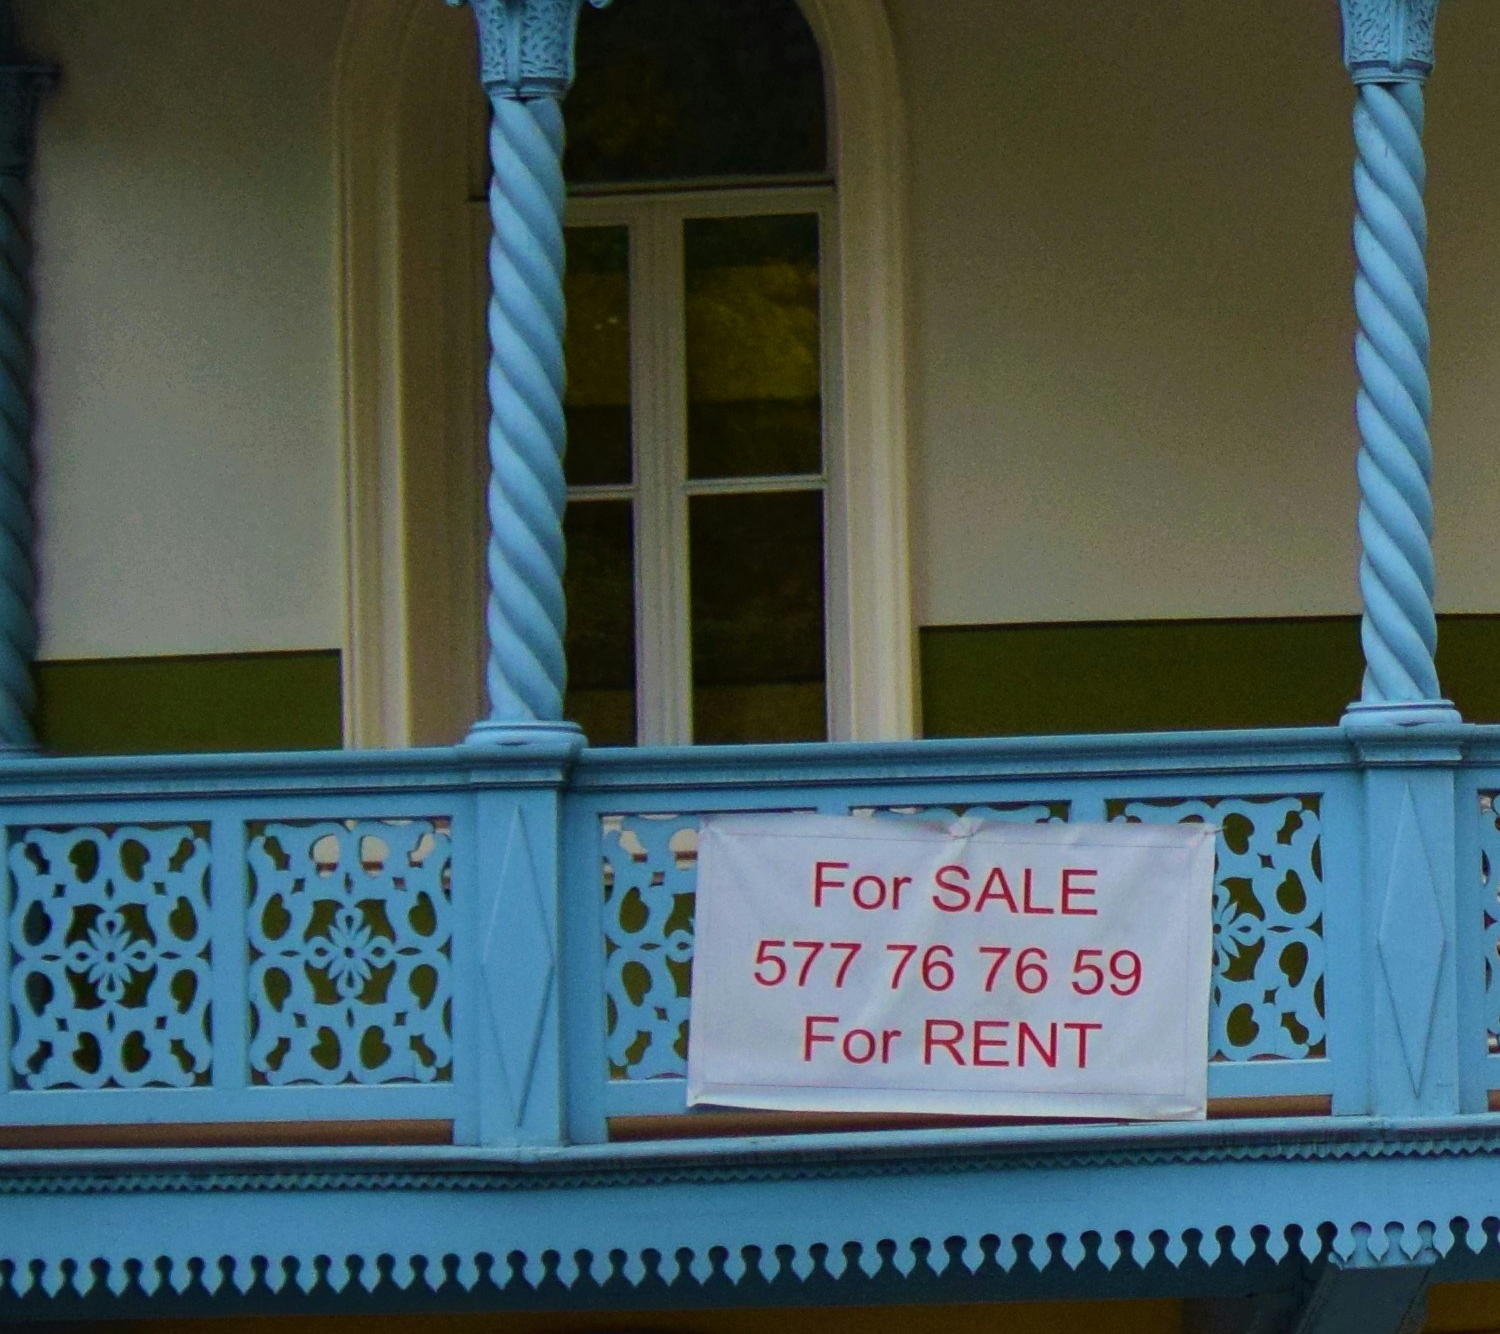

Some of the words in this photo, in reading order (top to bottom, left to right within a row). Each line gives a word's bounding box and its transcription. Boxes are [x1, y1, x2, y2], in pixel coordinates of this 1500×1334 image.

[813, 861, 912, 910] For
[932, 865, 1099, 916] SALE
[754, 939, 862, 989] 577
[886, 944, 956, 992] 76
[978, 946, 1050, 994] 76
[1071, 949, 1143, 996] 59
[803, 1015, 902, 1064] For
[923, 1019, 1102, 1069] RENT
